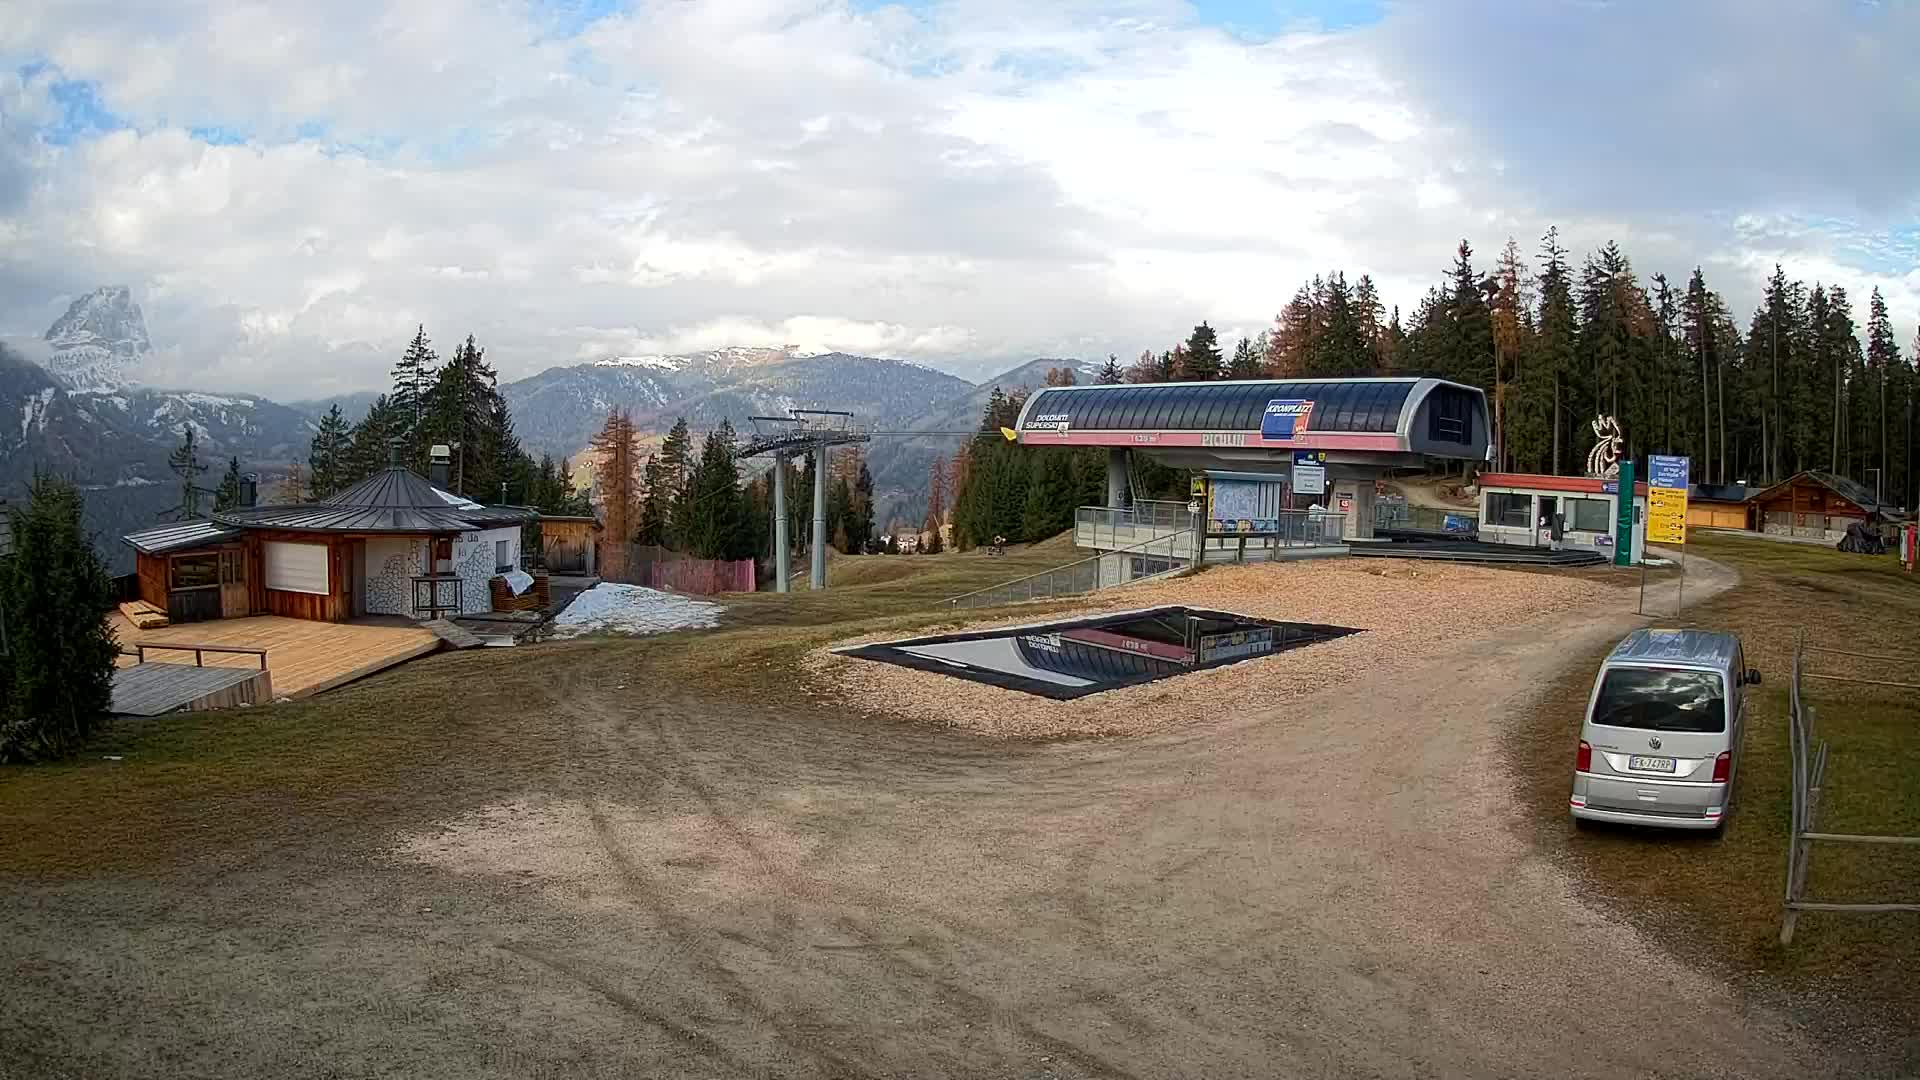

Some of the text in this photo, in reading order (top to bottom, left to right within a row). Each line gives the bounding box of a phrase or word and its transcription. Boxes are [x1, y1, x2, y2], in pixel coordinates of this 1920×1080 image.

[1267, 404, 1312, 413] KRONPLATZ
[1036, 414, 1068, 422] DOLOMITI
[1026, 421, 1058, 429] SUPERSKI
